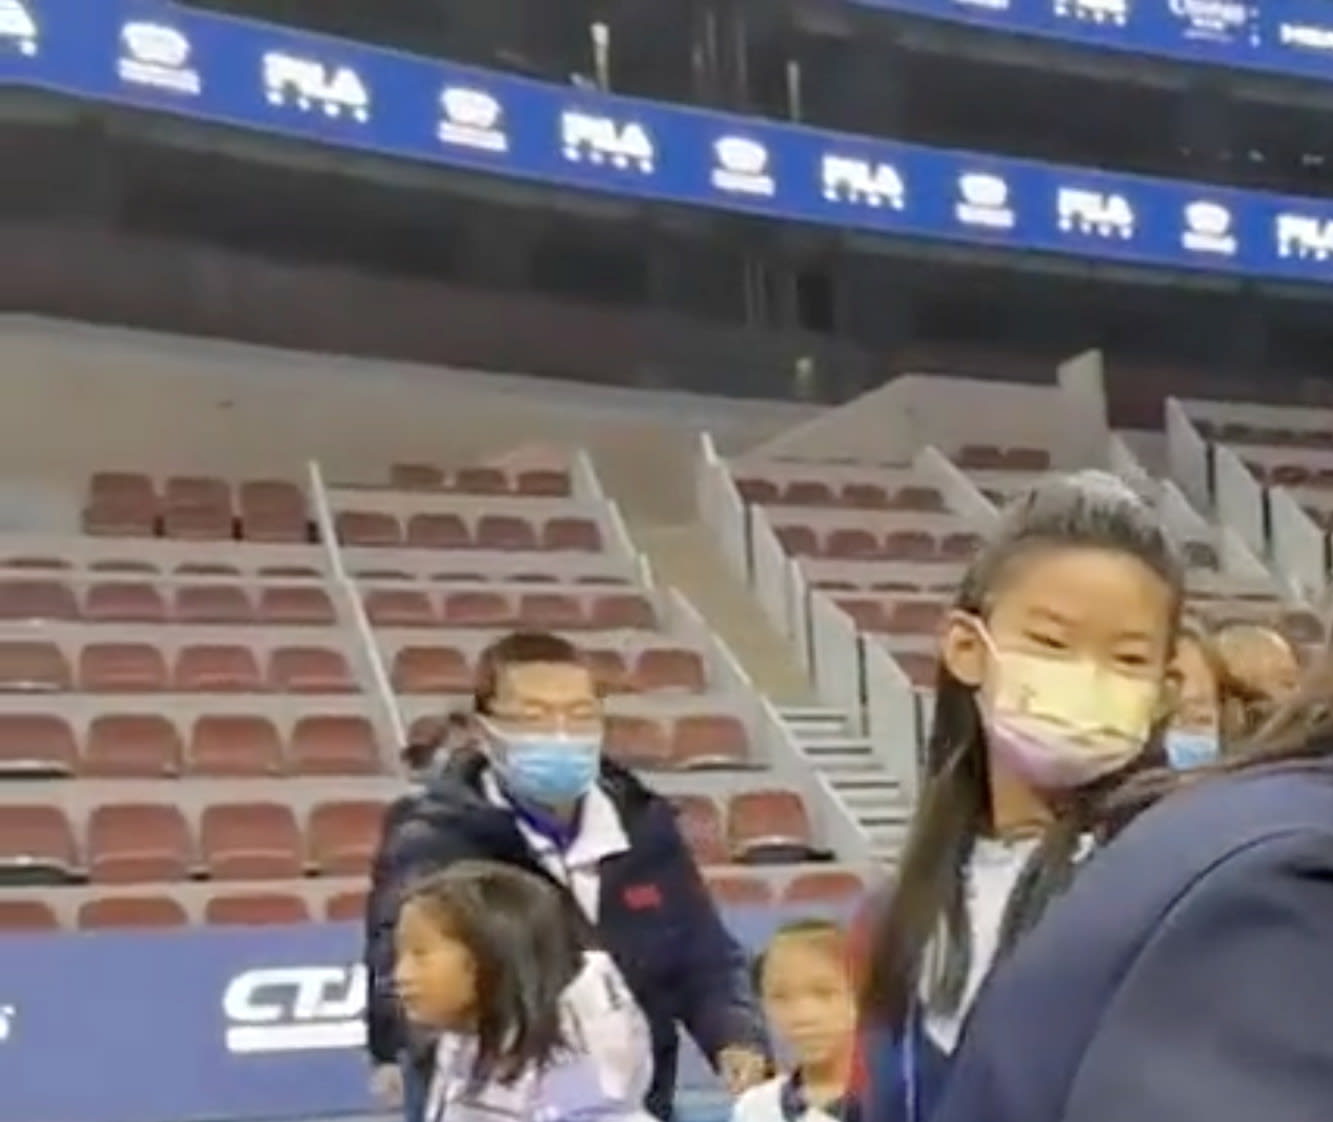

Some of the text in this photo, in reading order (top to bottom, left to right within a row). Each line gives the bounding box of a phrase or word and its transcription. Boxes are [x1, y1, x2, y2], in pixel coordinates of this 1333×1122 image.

[263, 52, 368, 107] FILA
[562, 112, 655, 160] FILA
[822, 155, 904, 197] FILA
[1058, 187, 1133, 225] FILA
